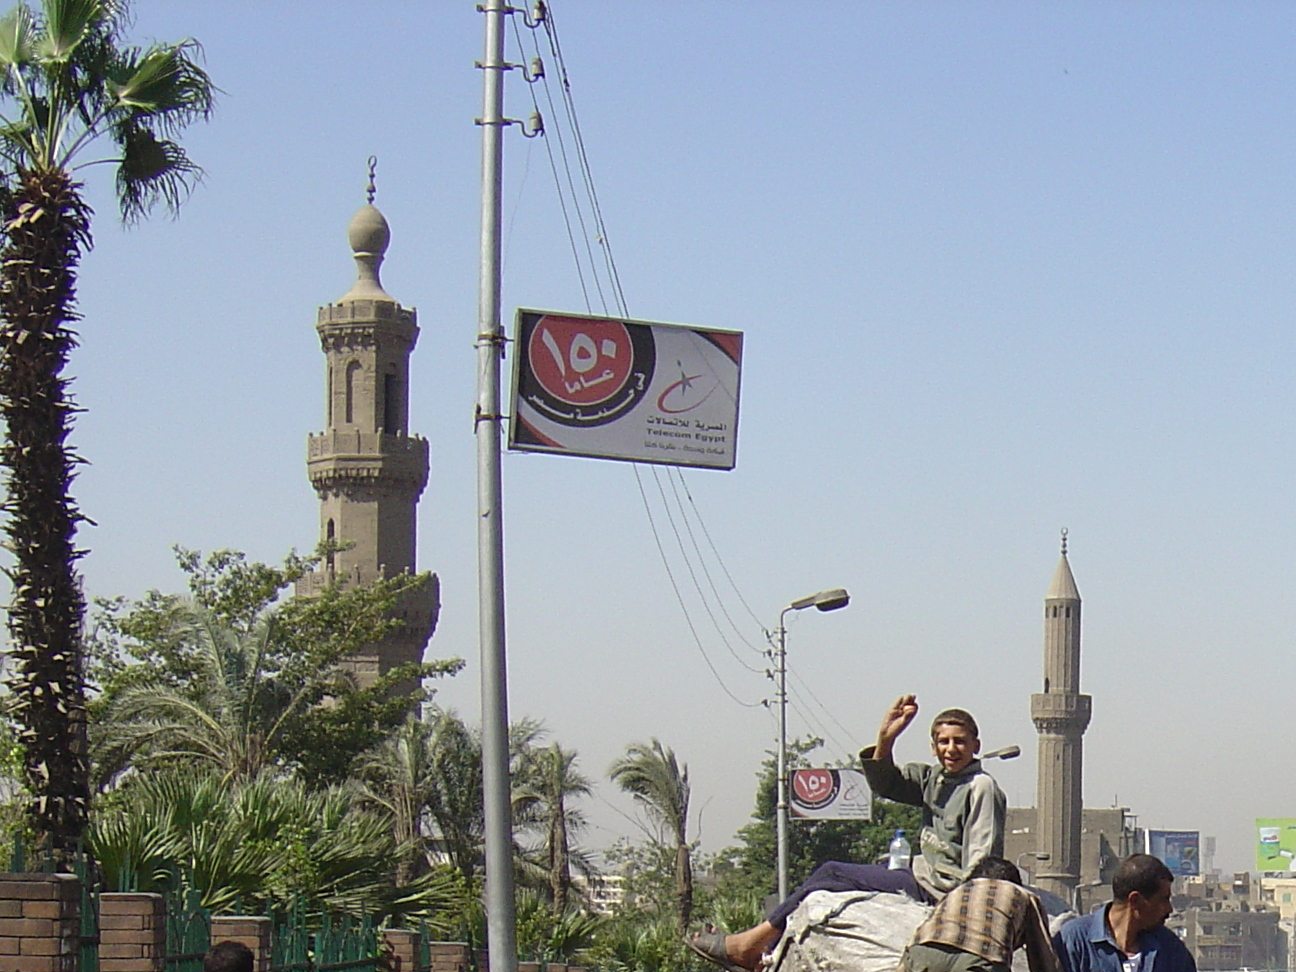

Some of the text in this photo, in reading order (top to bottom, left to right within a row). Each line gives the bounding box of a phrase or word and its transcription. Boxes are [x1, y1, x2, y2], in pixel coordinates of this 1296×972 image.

[541, 328, 617, 377] ١٥٠
[647, 427, 726, 443] Telecom Egypt
[797, 774, 827, 793] ١٥٠
